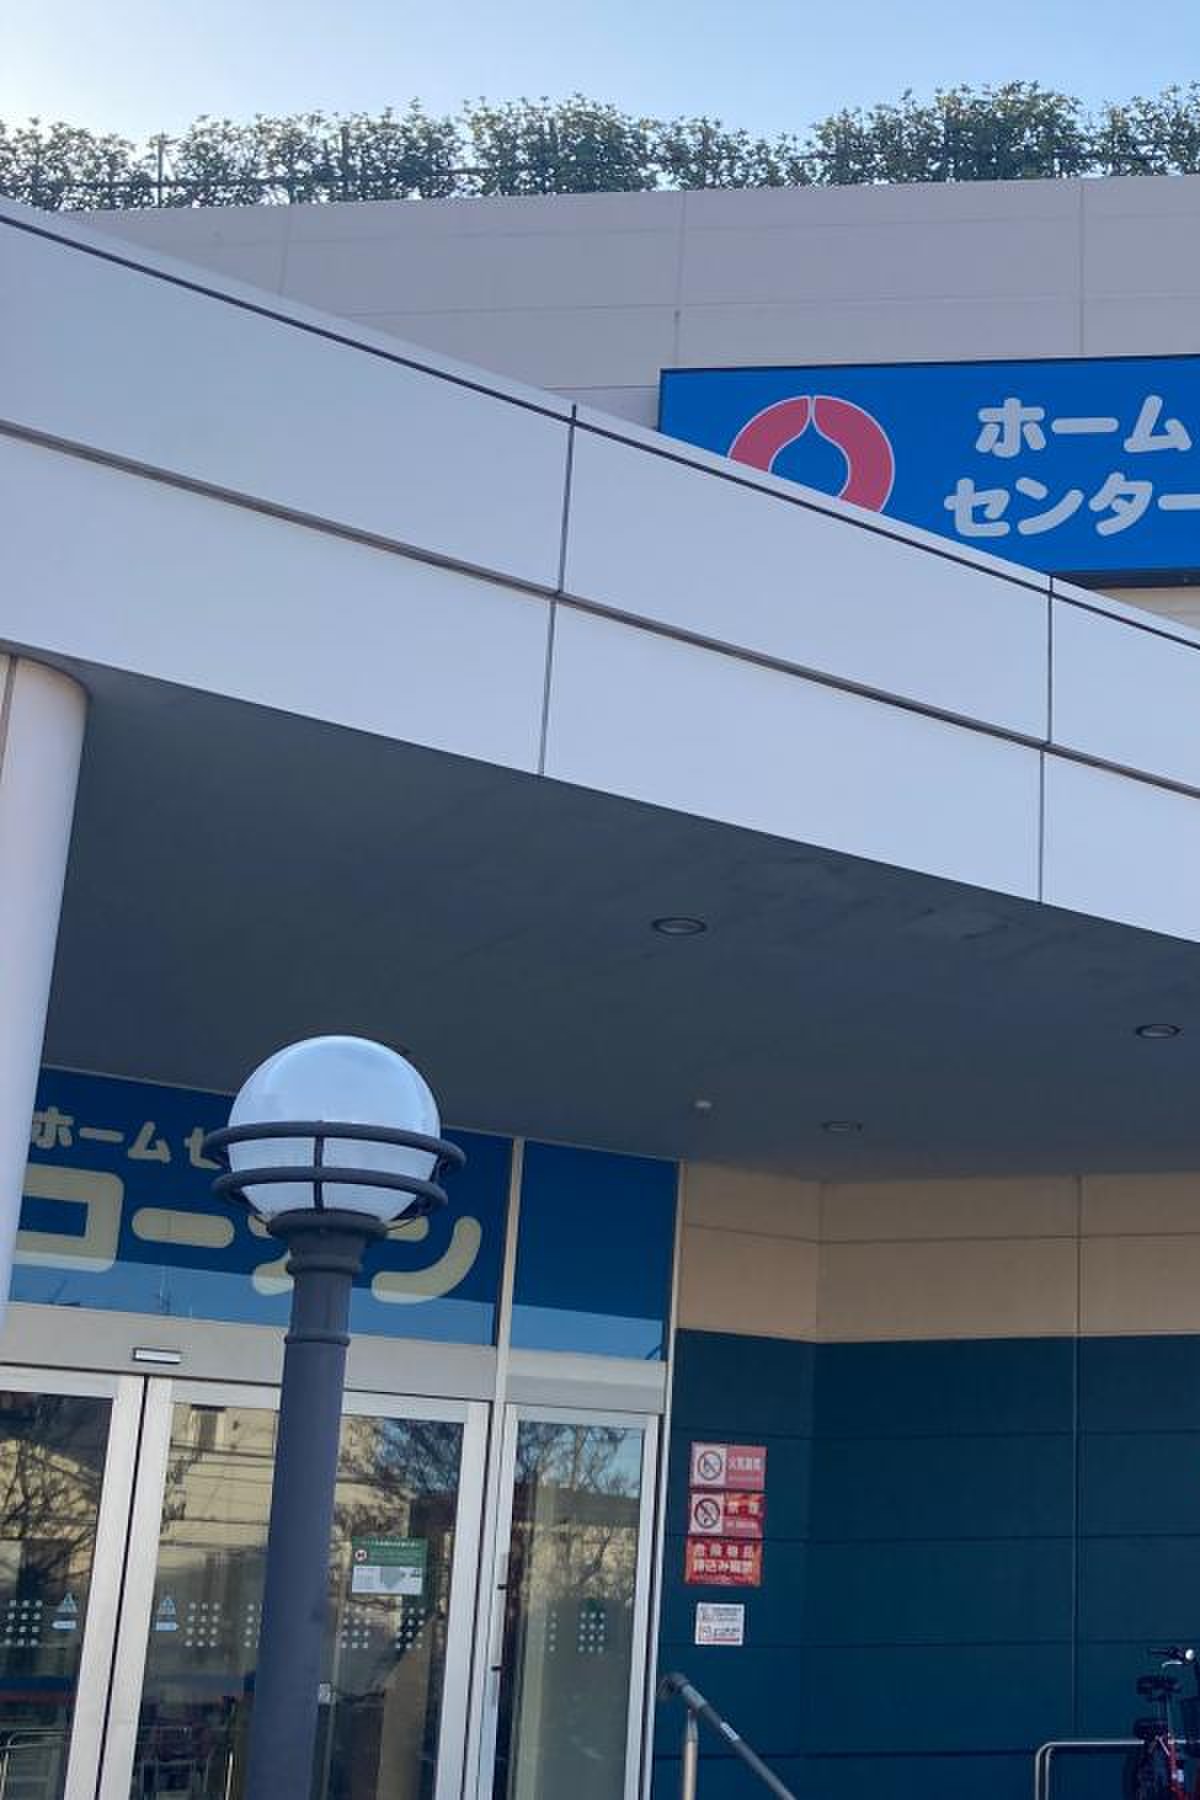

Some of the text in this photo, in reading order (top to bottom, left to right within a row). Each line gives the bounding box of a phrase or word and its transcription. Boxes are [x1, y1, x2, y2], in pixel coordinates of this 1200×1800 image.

[976, 395, 1192, 457] ホーム
[15, 1162, 482, 1304] コーン
